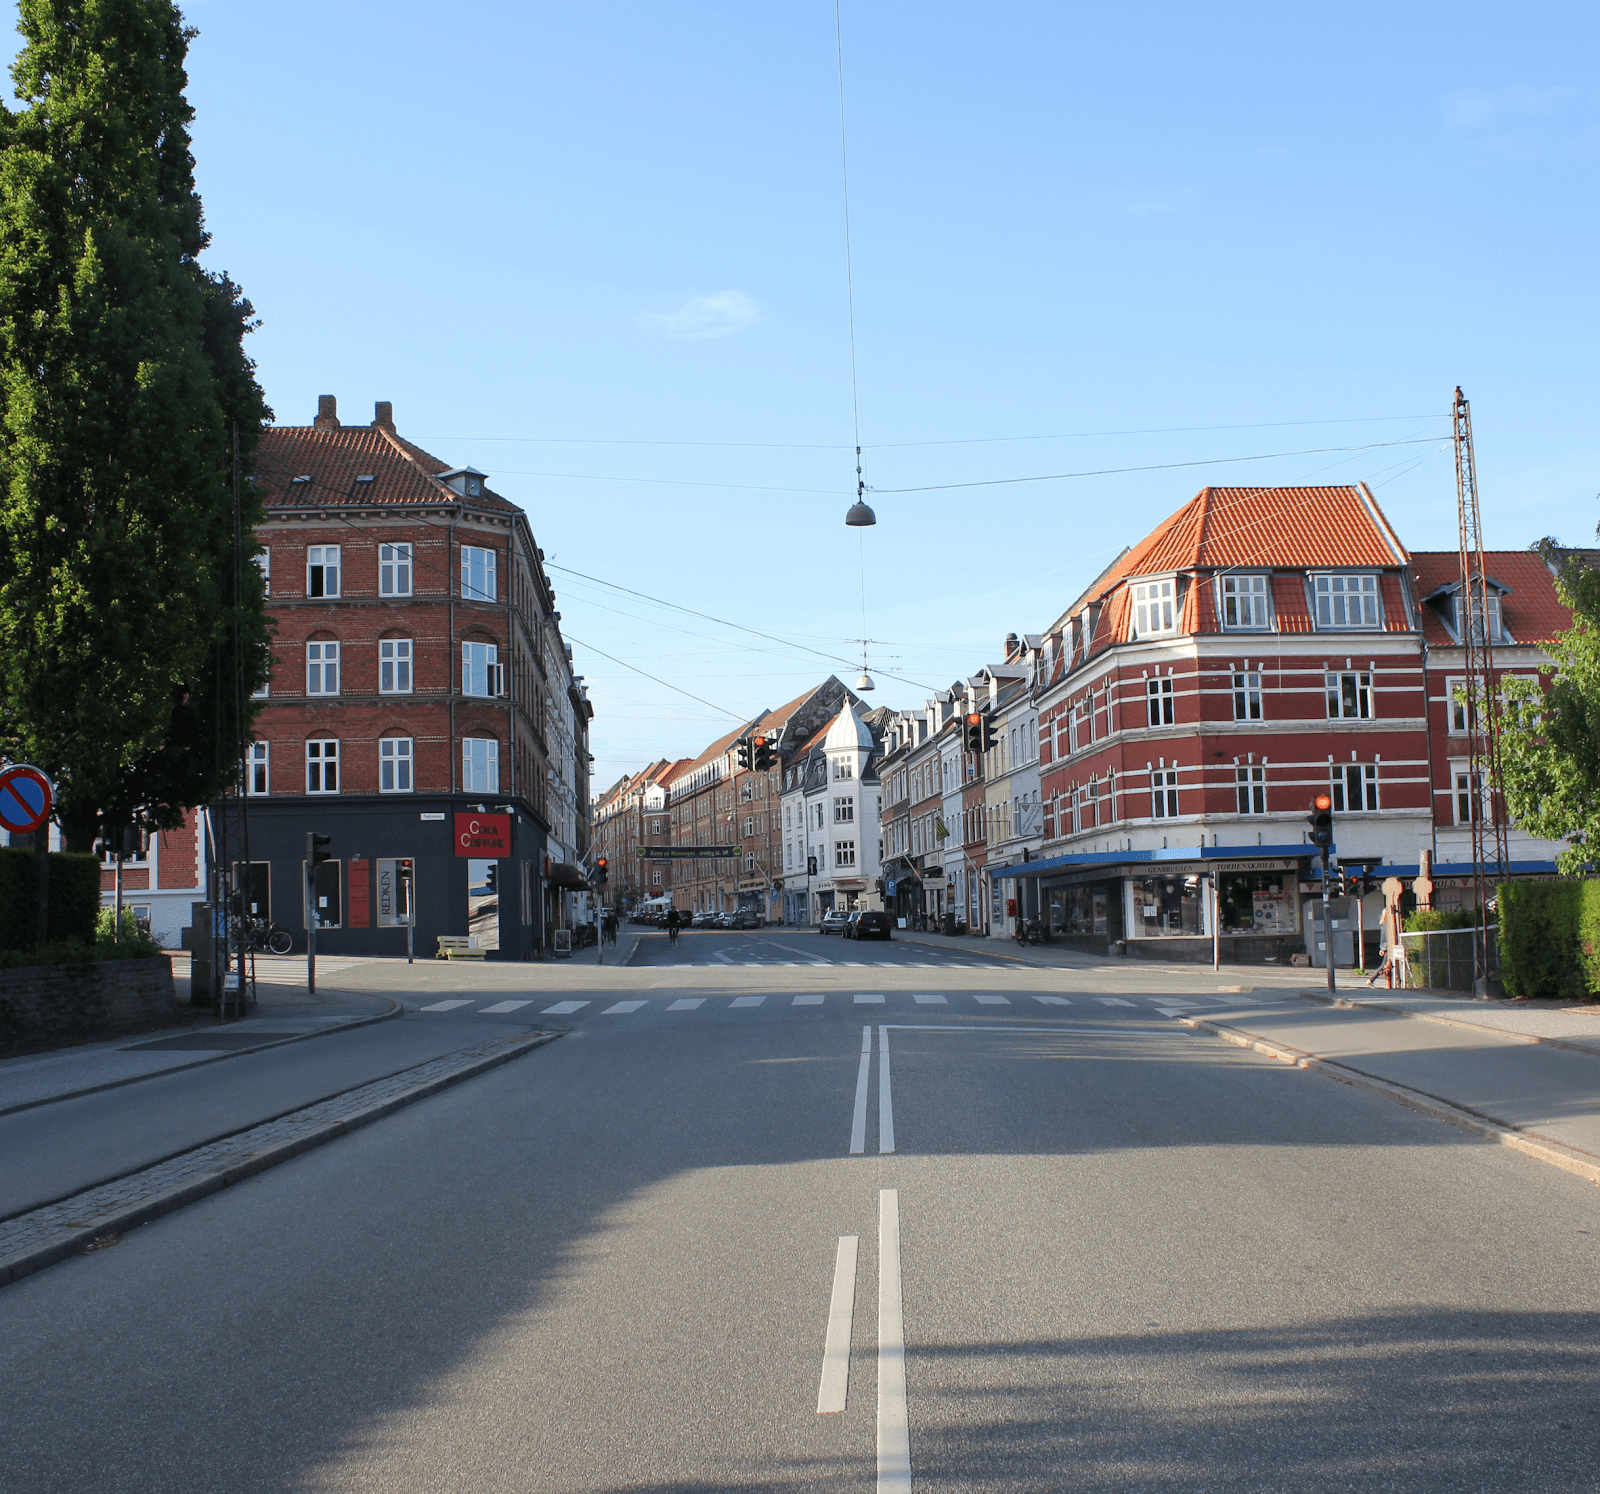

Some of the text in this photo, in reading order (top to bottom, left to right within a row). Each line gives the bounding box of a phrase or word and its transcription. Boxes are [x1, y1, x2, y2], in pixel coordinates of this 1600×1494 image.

[1148, 865, 1193, 874] GENBRUGSEN
[1216, 862, 1275, 870] TORDENSKJOLD
[381, 871, 390, 915] REDKEN
